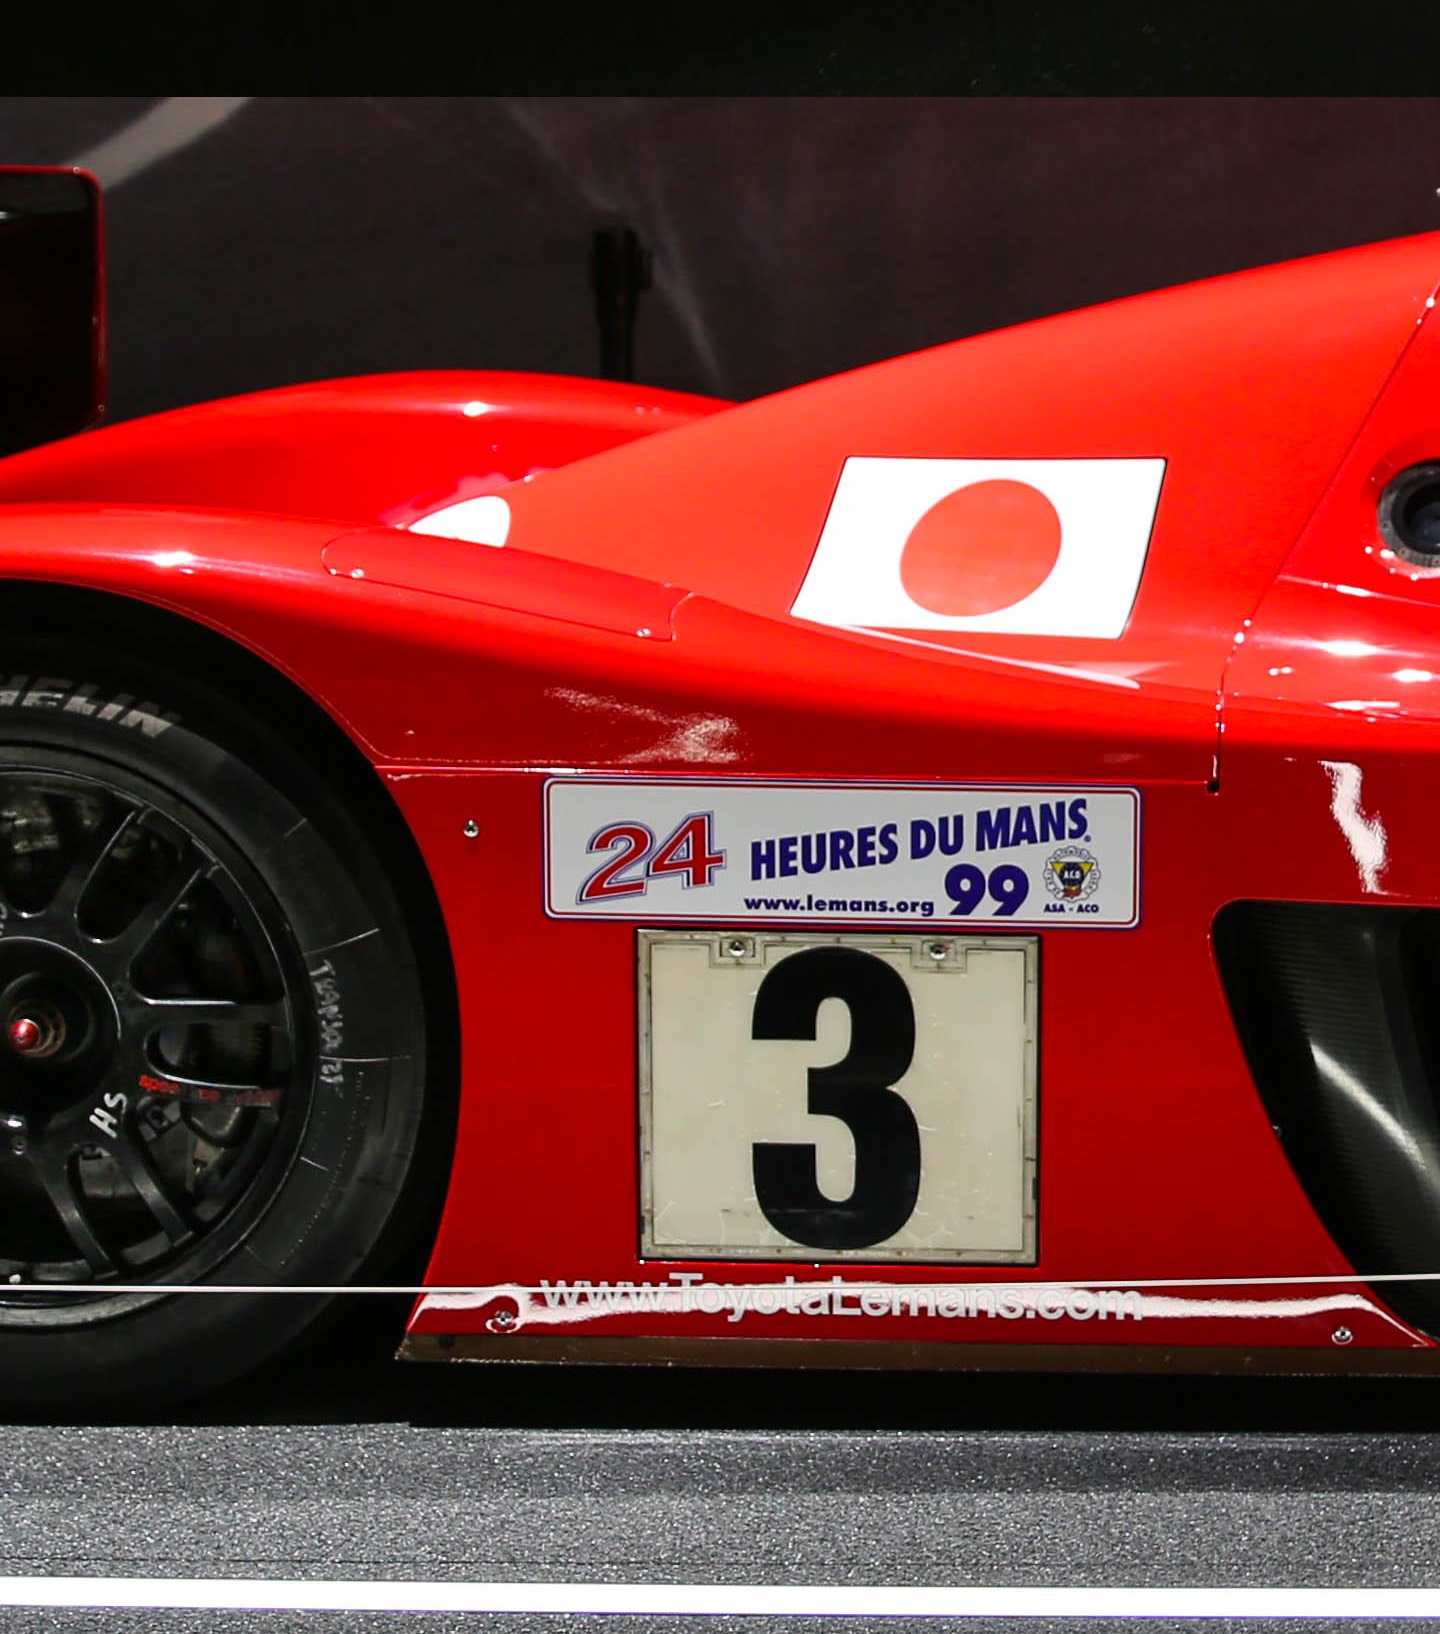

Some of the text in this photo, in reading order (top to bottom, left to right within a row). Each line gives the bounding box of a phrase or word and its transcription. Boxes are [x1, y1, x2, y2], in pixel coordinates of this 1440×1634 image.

[576, 797, 1088, 905] 24 HEURES DU MANS
[743, 893, 935, 917] www.lemans.org
[945, 863, 1030, 917] 99
[1043, 903, 1099, 914] ASA ACO
[751, 945, 922, 1251] 3
[539, 1272, 1144, 1324] www.ToyotaLemans.com
